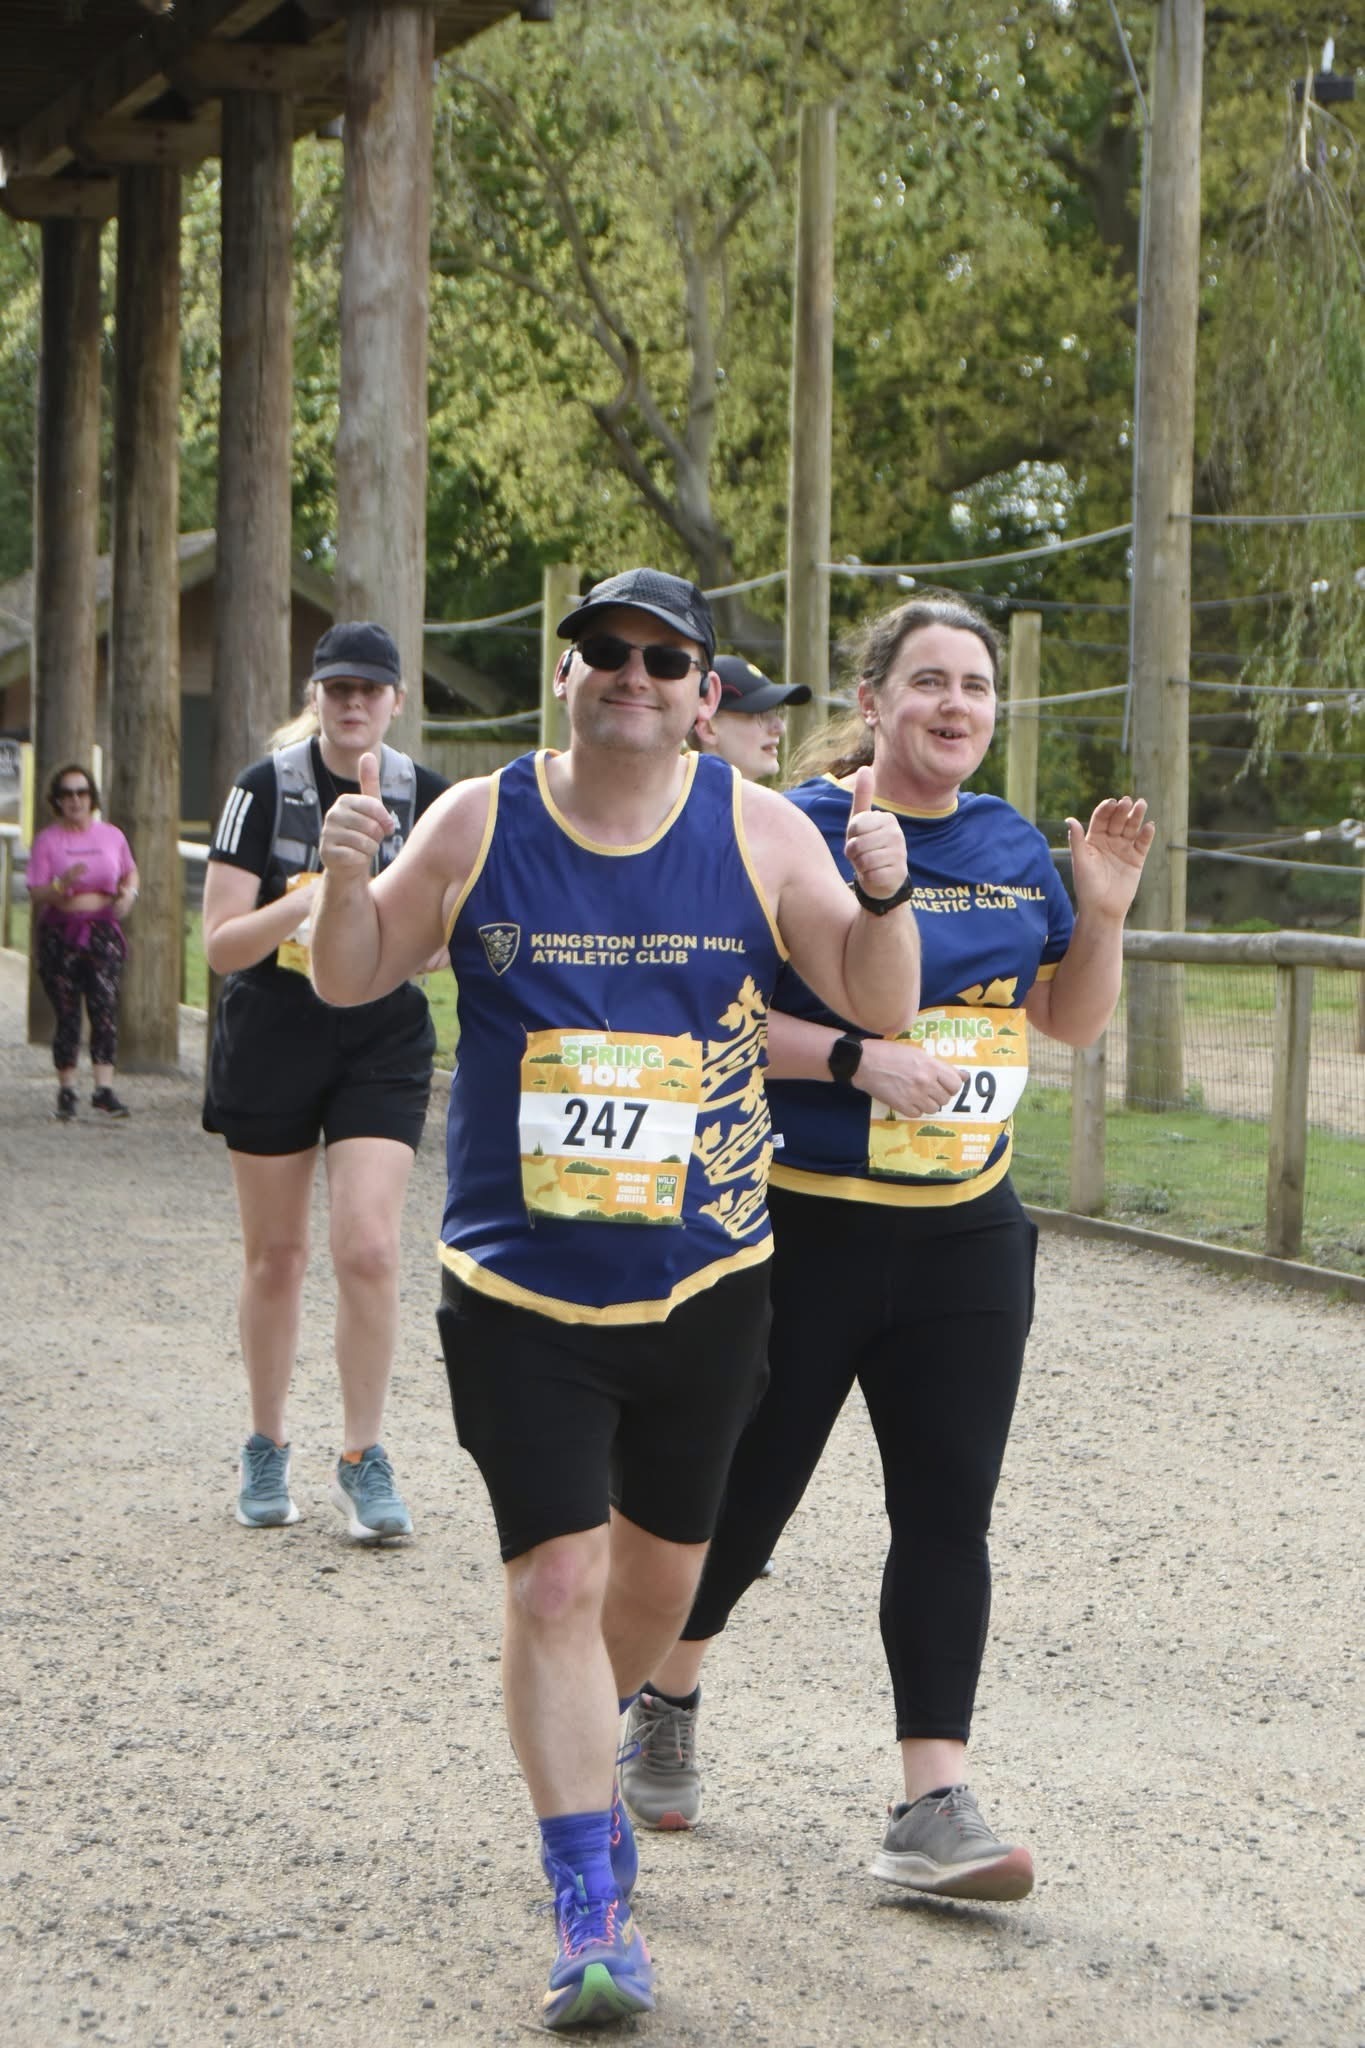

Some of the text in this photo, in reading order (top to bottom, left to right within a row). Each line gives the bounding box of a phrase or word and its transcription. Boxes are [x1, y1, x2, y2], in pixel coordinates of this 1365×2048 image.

[911, 885, 971, 899] GSTON
[975, 896, 1017, 909] CLUB
[531, 933, 746, 954] KINGSTON UPON HULL
[532, 950, 689, 966] ATHLETIC CLUB
[910, 1017, 993, 1040] SPRING
[561, 1043, 665, 1070] SPRING
[921, 1037, 978, 1058] 10K
[579, 1066, 643, 1088] 10K
[939, 1069, 997, 1113] 29
[562, 1097, 649, 1149] 247
[657, 1176, 676, 1185] WILD
